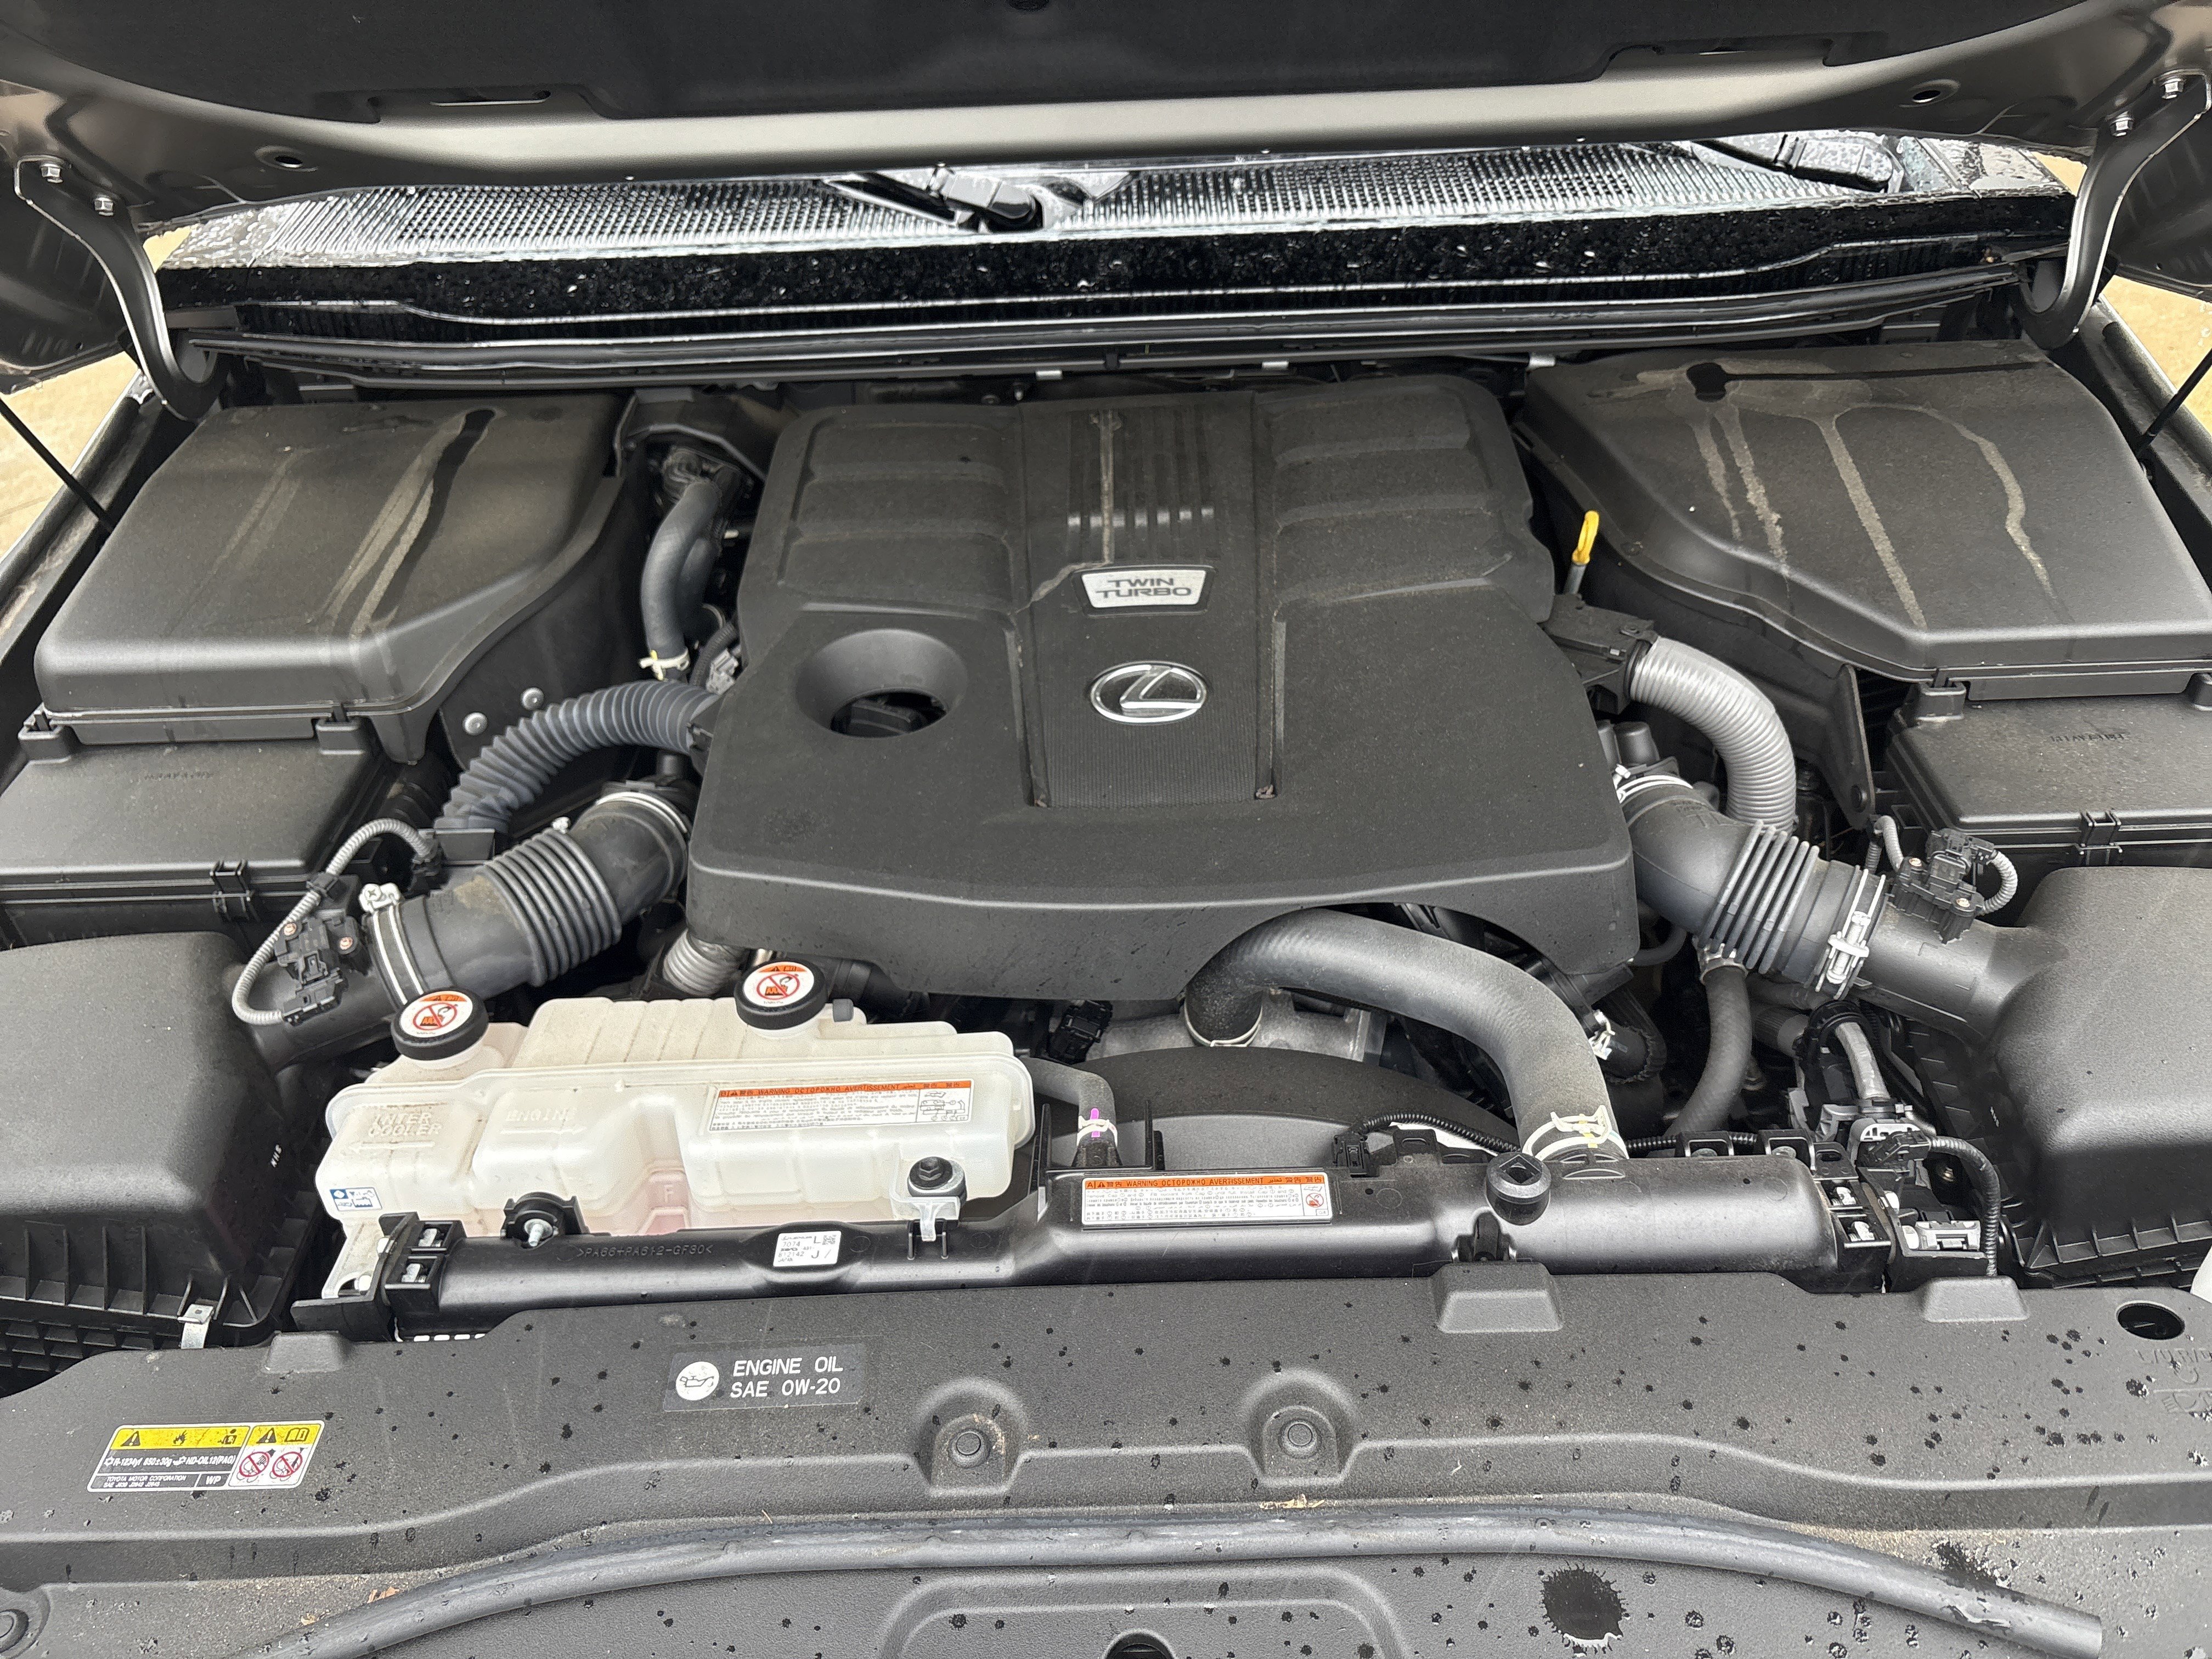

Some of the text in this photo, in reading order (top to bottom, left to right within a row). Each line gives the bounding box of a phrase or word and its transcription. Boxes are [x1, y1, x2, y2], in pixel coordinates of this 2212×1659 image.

[1108, 578, 1175, 588] TWIN
[1096, 587, 1192, 598] TURBO
[374, 1112, 432, 1125] INTER
[369, 1123, 442, 1138] COOLER
[1209, 1177, 1264, 1186] AVERTISSEMENT
[663, 1184, 674, 1203] F
[811, 1250, 820, 1259] J
[733, 1356, 844, 1376] ENGINE OIL
[730, 1378, 841, 1398] SAE 0W-20
[113, 1457, 143, 1468] R-1234yf
[205, 1475, 222, 1485] WP
